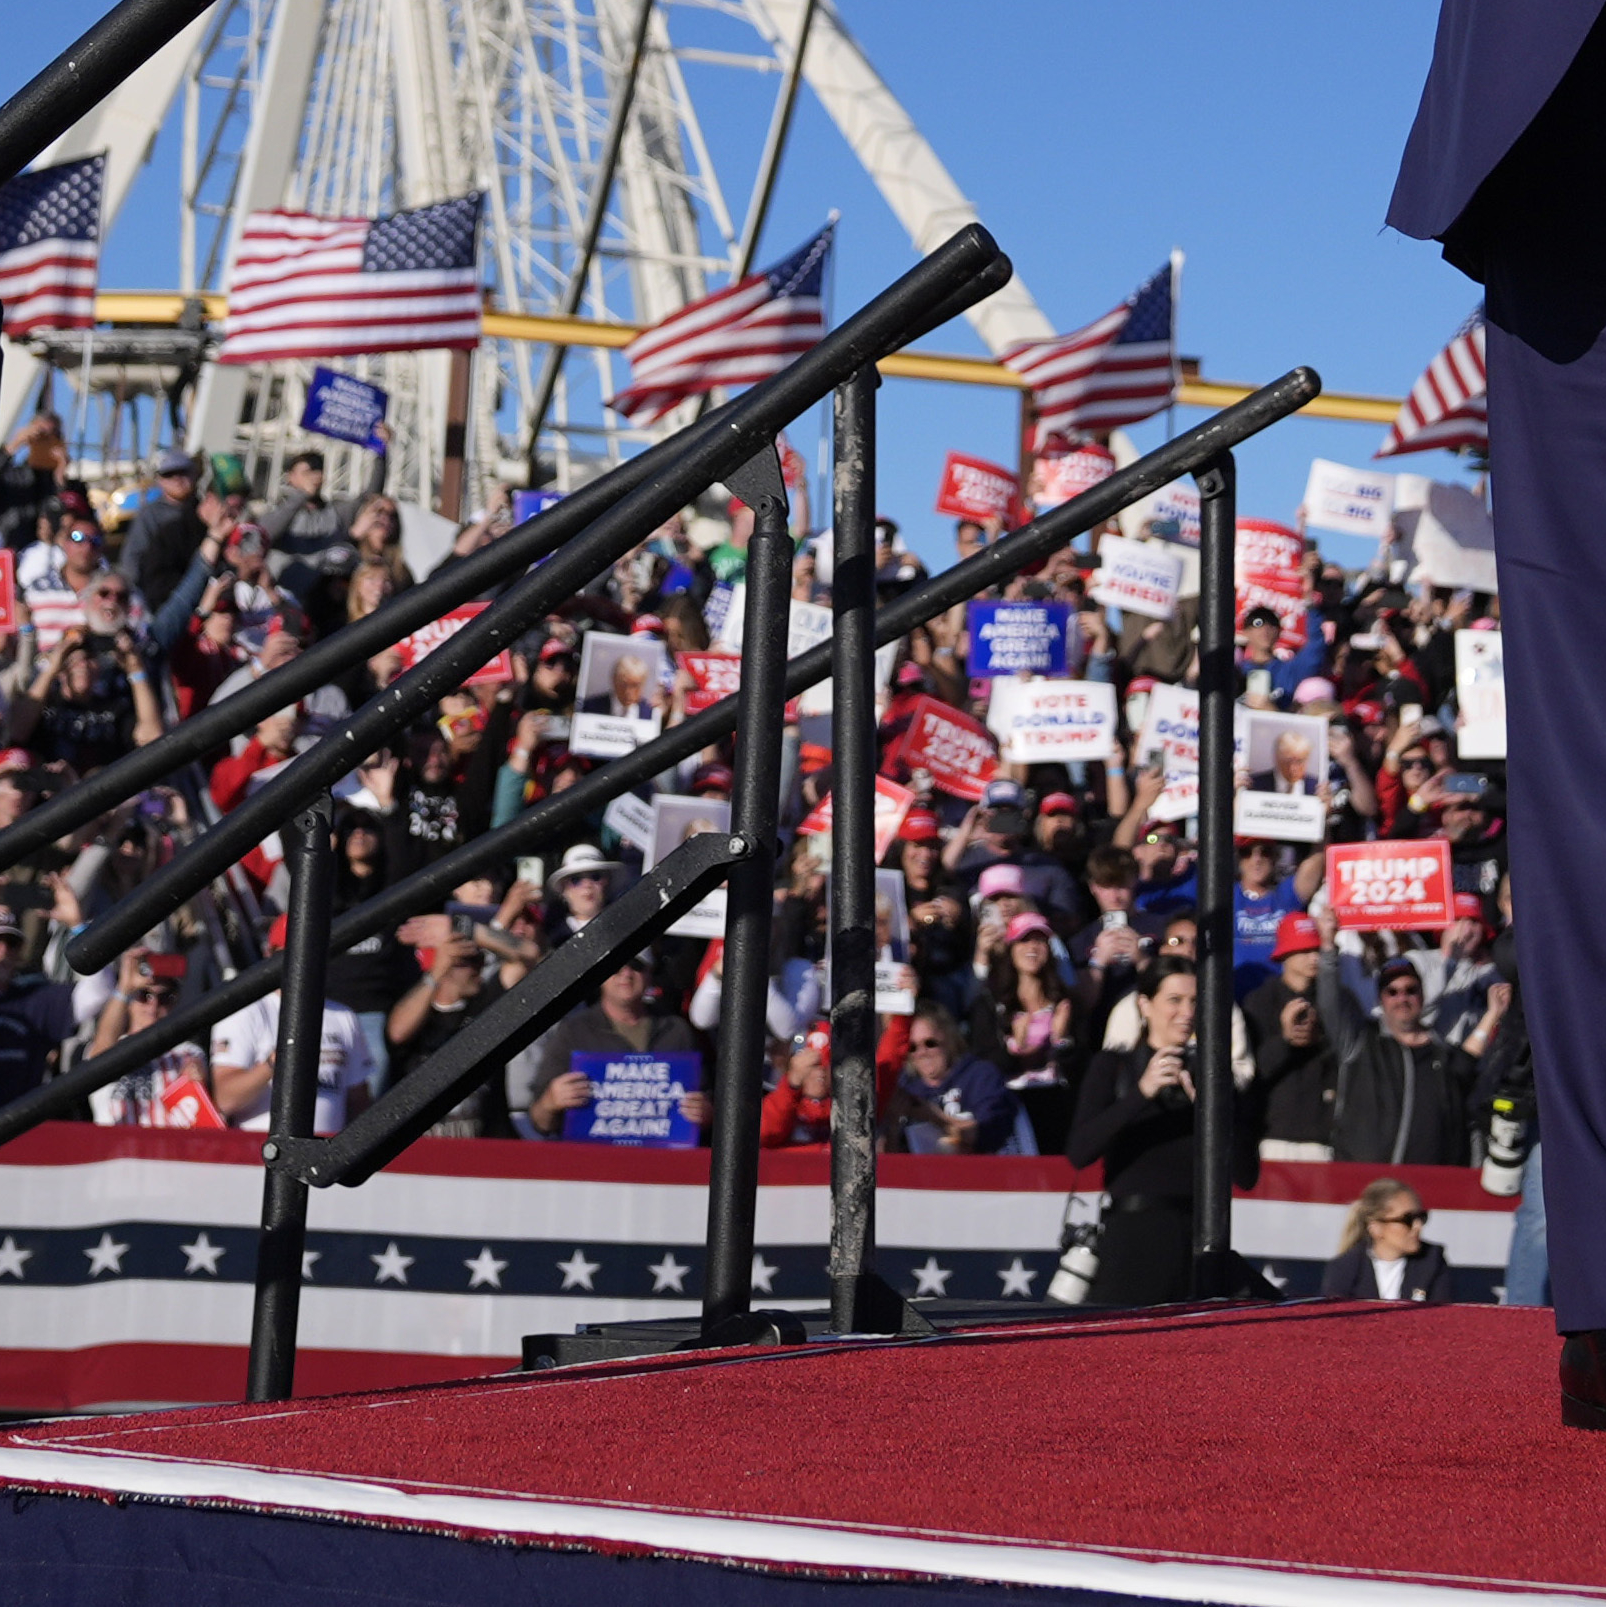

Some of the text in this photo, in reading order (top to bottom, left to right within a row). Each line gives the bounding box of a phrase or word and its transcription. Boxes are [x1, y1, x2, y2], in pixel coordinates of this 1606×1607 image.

[952, 463, 1018, 494] TRUMP
[994, 608, 1048, 623] MAKE
[978, 622, 1060, 640] AMERICA
[989, 637, 1050, 654] GREAT
[1033, 693, 1089, 708] VOTE
[1012, 711, 1106, 727] DONALD
[1022, 729, 1099, 745] TRUMP
[922, 741, 989, 777] 2024
[1336, 856, 1440, 883] TRUMP
[1349, 879, 1427, 905] 2024
[604, 1062, 671, 1082] MAKE
[594, 1098, 673, 1119] GREAT
[588, 1117, 673, 1138] AGAIN!
